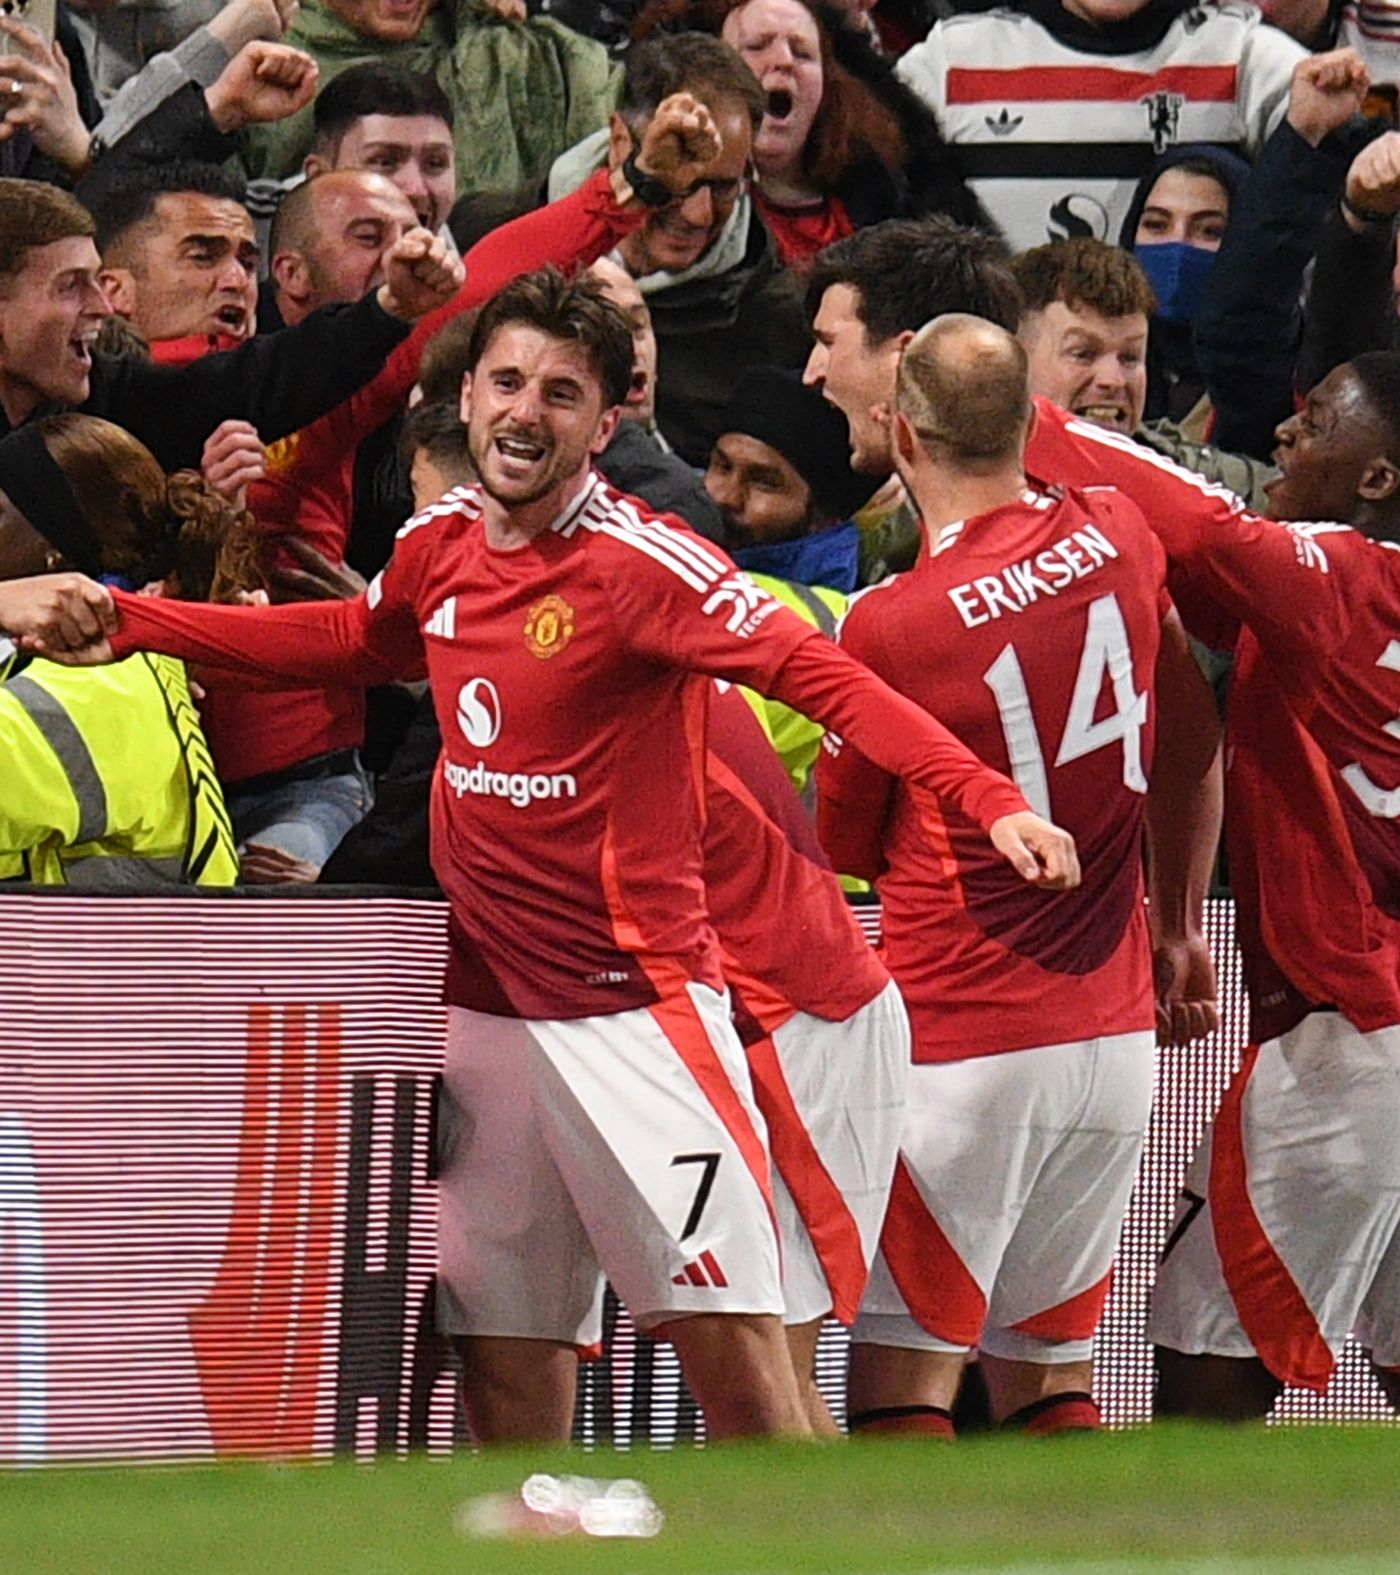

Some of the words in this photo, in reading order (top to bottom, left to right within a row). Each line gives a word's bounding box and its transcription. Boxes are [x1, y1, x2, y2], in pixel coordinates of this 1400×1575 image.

[947, 523, 1119, 629] ERIKSEN
[983, 591, 1149, 824] 14
[669, 1152, 723, 1243] 7
